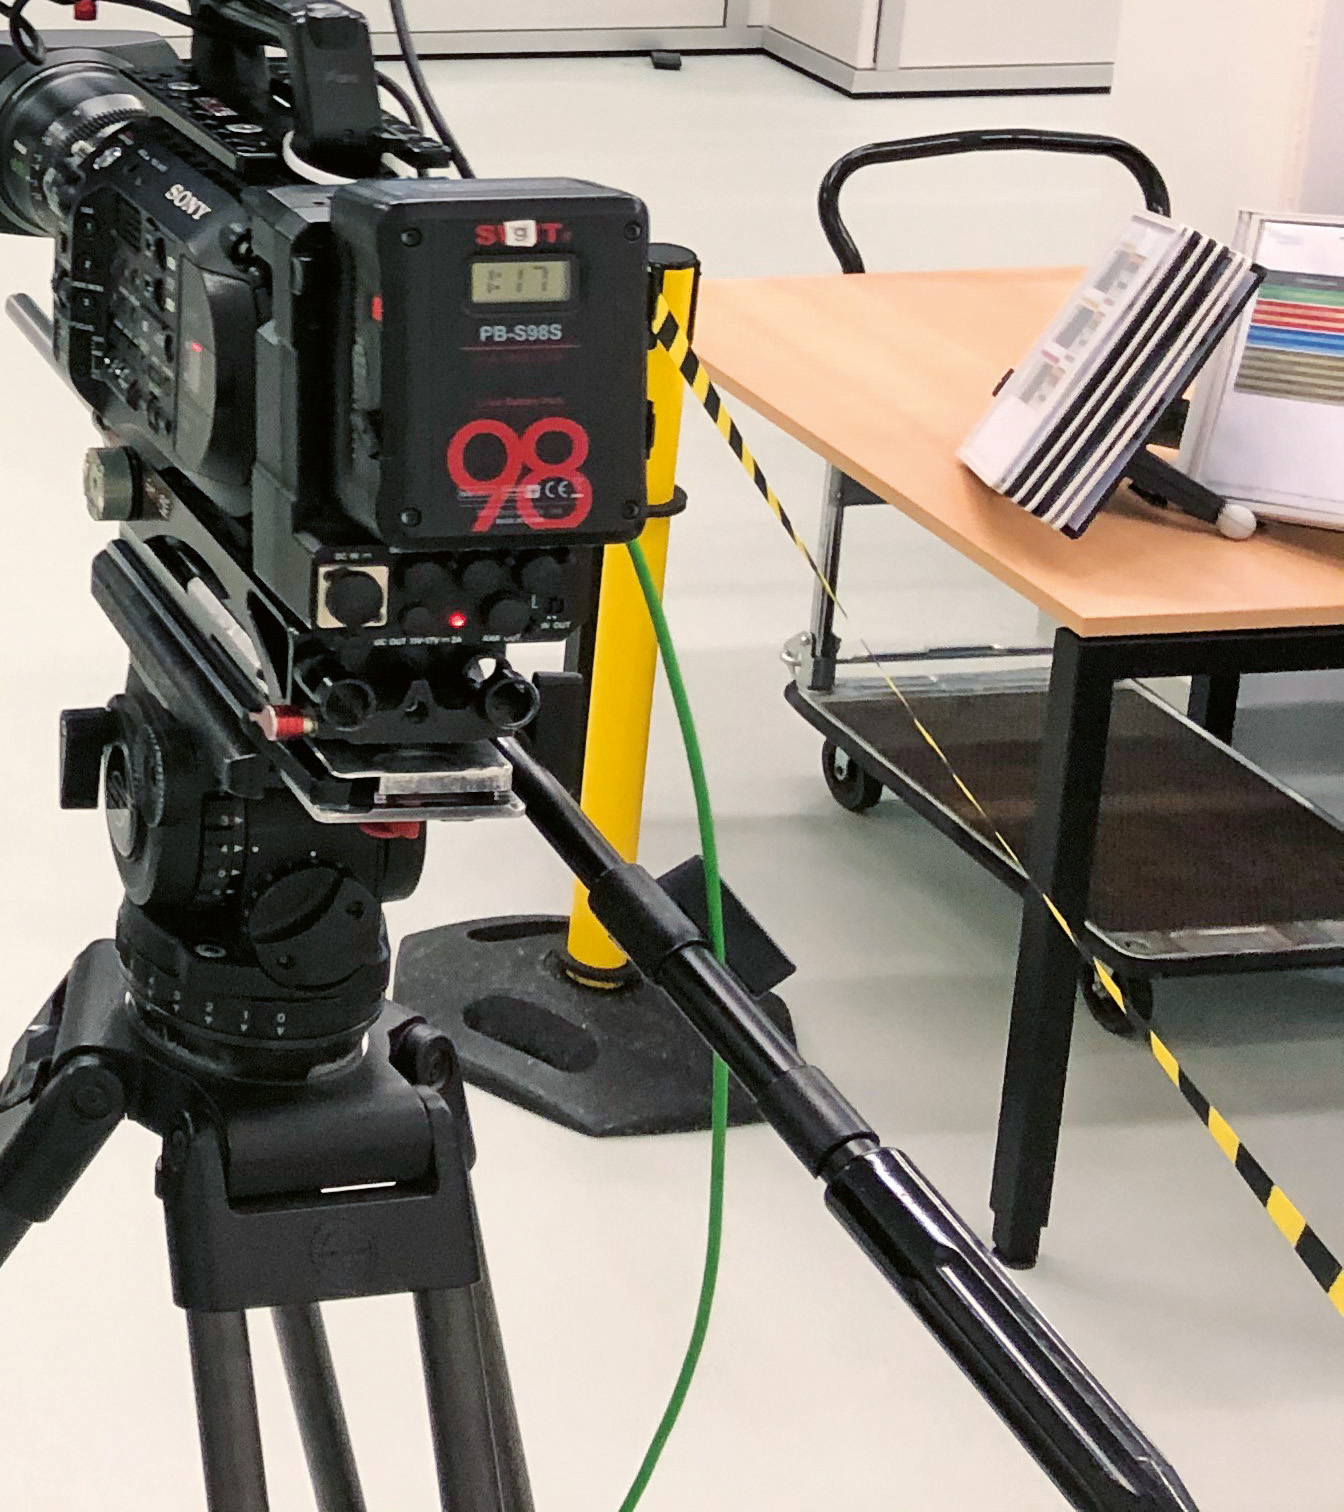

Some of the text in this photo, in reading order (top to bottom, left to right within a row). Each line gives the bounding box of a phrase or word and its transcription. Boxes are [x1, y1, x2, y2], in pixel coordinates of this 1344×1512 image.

[164, 183, 212, 220] SONY
[479, 324, 563, 342] PB-S98S
[447, 416, 593, 533] 98
[553, 620, 571, 630] OUT
